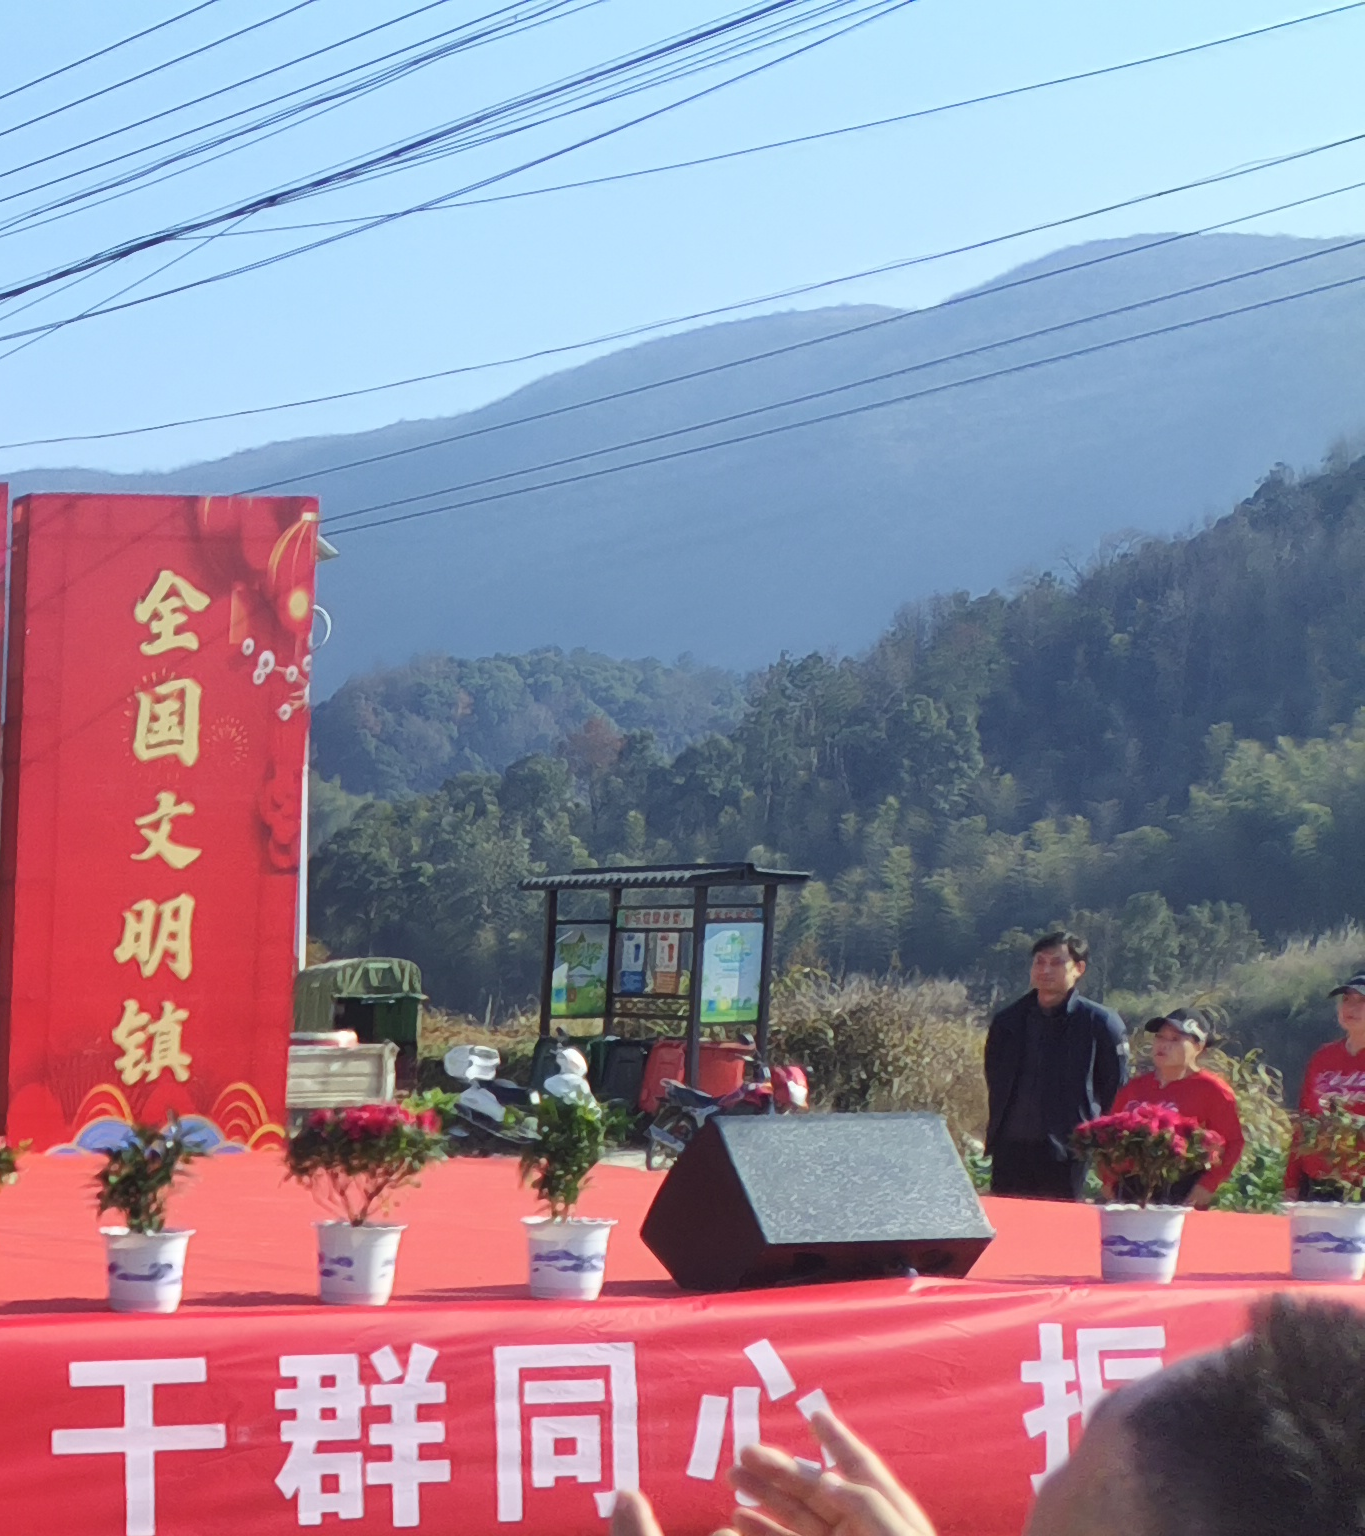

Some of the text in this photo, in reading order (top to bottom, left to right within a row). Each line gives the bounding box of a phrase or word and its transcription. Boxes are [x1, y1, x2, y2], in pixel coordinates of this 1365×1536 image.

[111, 569, 212, 1087] 全国文明镇
